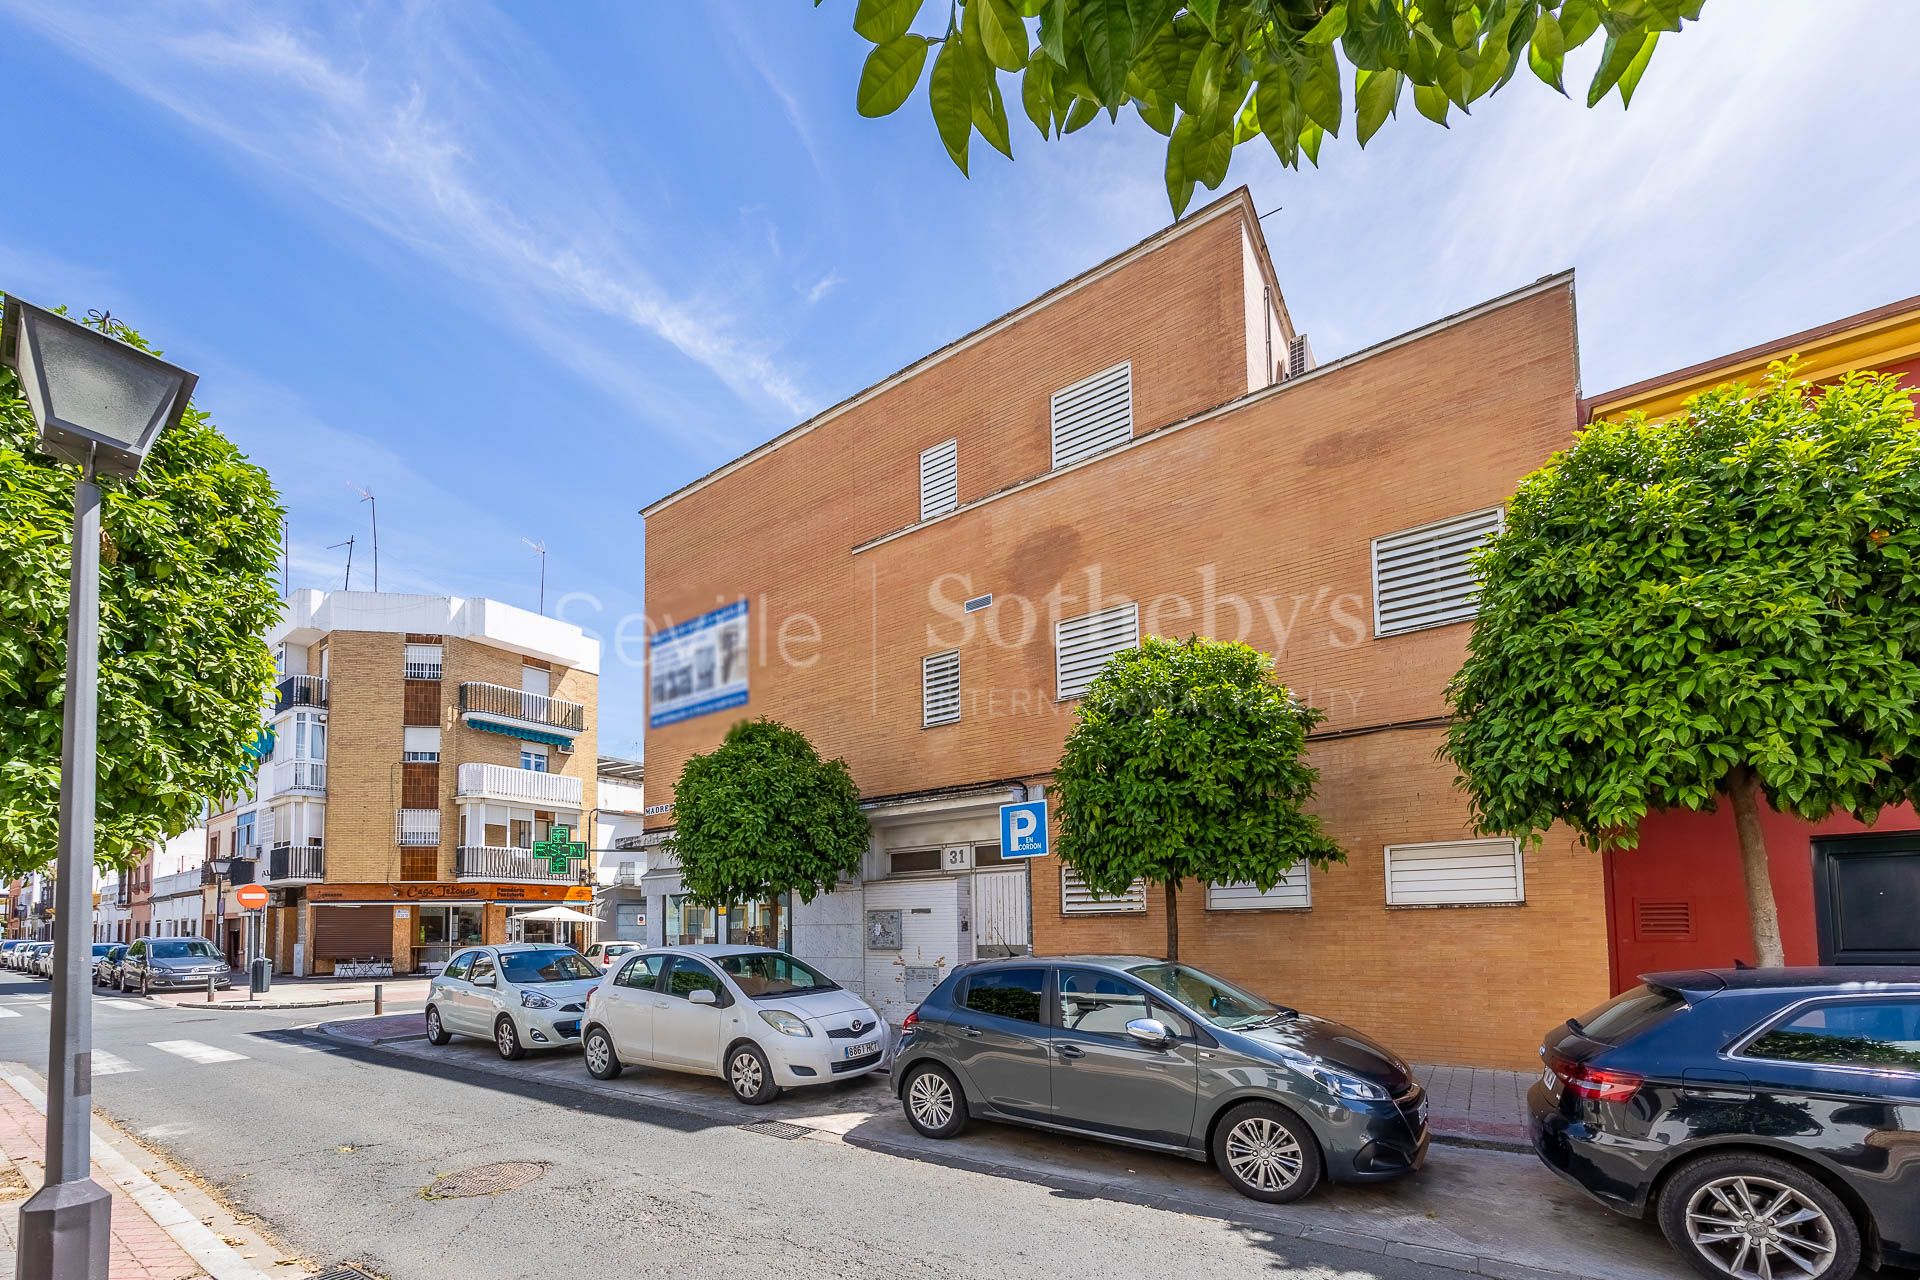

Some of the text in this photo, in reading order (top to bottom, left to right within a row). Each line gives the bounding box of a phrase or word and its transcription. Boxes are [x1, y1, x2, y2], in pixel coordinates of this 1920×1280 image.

[646, 804, 669, 815] MADRE
[1010, 810, 1037, 851] P
[949, 849, 965, 865] 31
[407, 885, 434, 898] Casa
